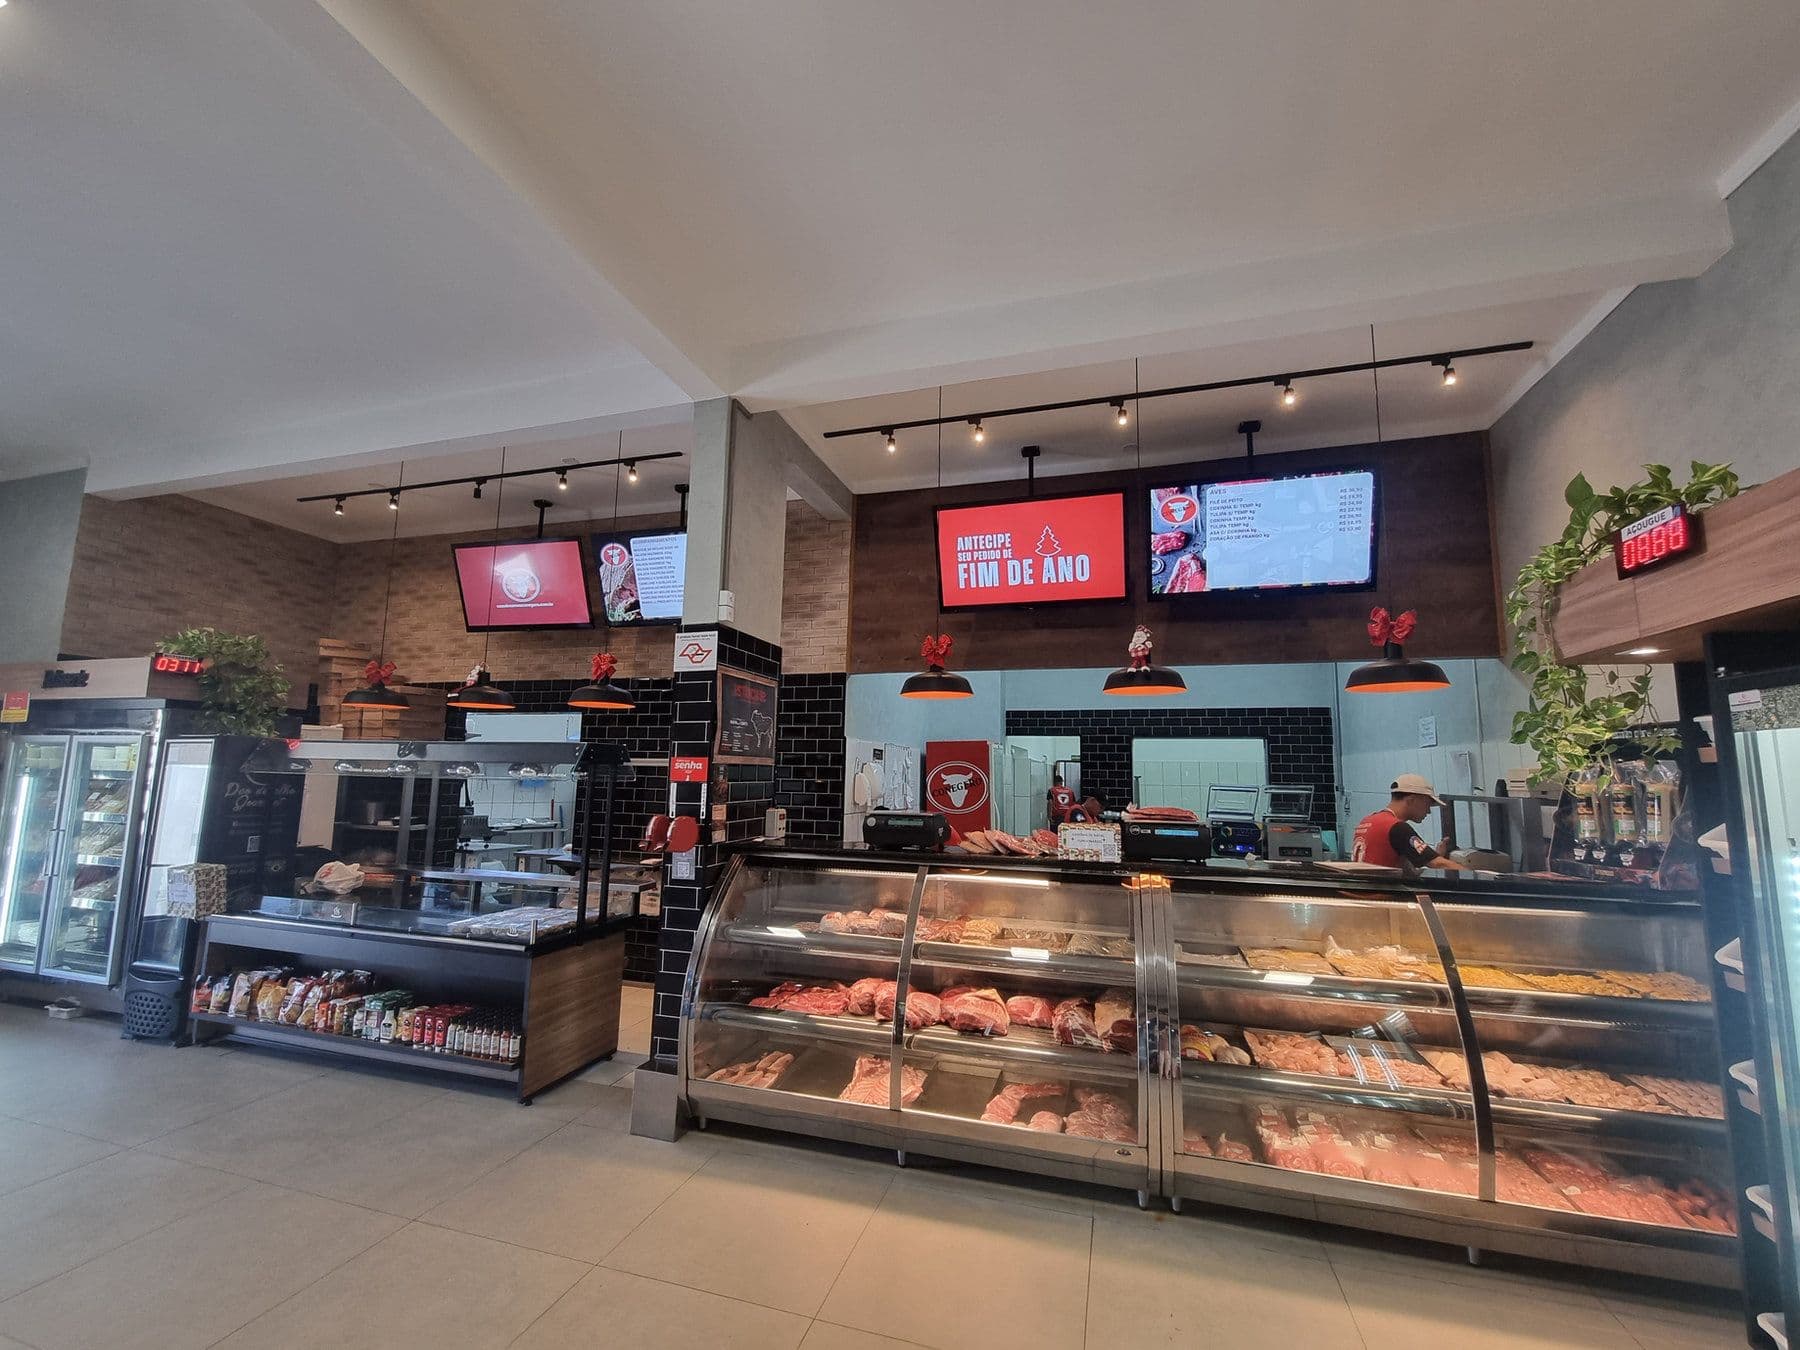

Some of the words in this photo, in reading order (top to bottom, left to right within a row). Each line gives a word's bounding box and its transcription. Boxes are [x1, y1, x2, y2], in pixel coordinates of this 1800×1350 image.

[957, 533, 1012, 551] ANTECIPE
[957, 551, 972, 562] SEU
[973, 549, 1001, 561] PEDIDO
[1003, 548, 1013, 559] DE
[957, 560, 1000, 589] FIM
[1007, 557, 1034, 586] DE
[1042, 554, 1091, 584] ANO
[157, 658, 200, 673] 0311
[674, 760, 703, 770] senha
[932, 777, 982, 797] CONEGERO
